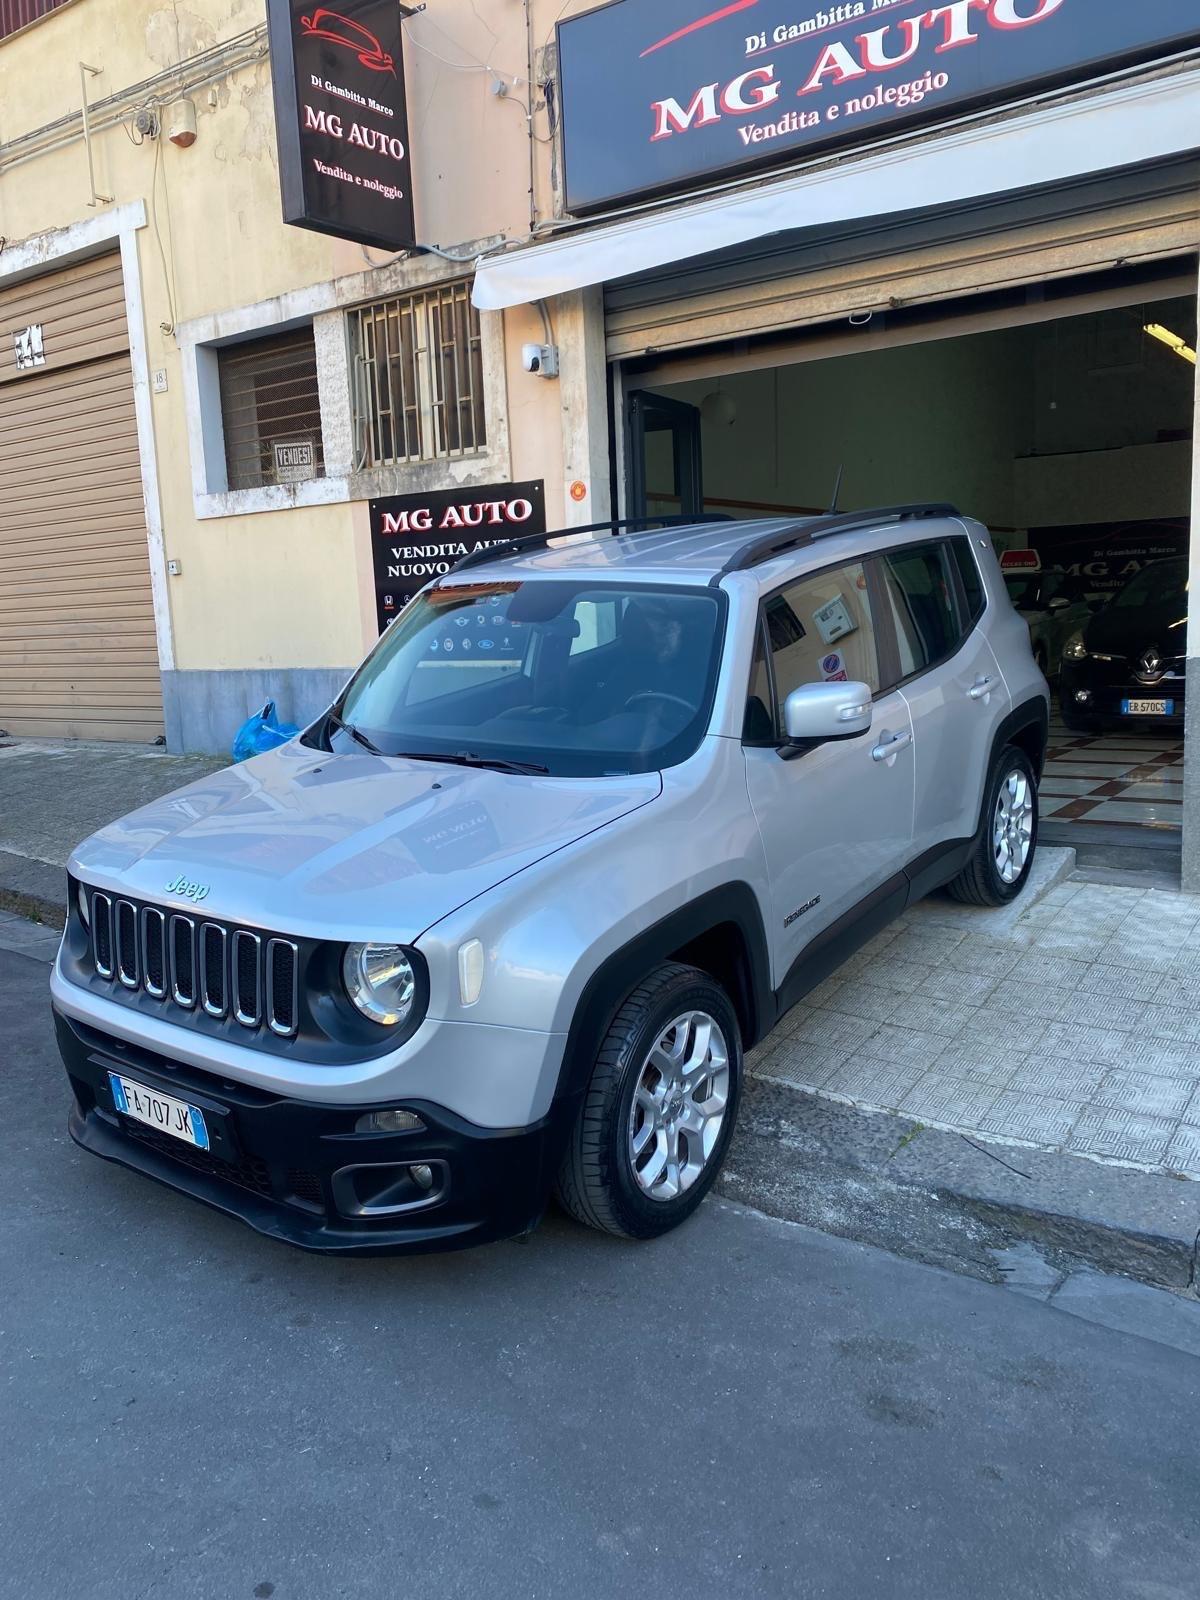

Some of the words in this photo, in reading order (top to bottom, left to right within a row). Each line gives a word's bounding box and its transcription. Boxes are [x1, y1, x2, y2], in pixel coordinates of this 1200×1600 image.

[745, 32, 767, 54] Di
[773, 1, 866, 44] Gambitta
[311, 74, 323, 88] Di
[325, 80, 366, 106] Gambitta
[368, 98, 394, 117] Marco
[650, 64, 781, 142] MG
[738, 111, 821, 146] Vendita
[826, 104, 840, 121] e
[844, 69, 949, 116] noleggio
[304, 104, 343, 138] MG
[348, 123, 405, 160] AUTO
[313, 158, 354, 184] Vendita
[355, 176, 362, 186] e
[363, 179, 403, 200] noleggio
[155, 372, 164, 384] 18
[277, 446, 311, 466] VENDESI
[381, 508, 433, 534] MG
[438, 498, 533, 529] AUTO
[387, 561, 450, 577] NUOVO
[391, 542, 469, 560] VENDITA
[163, 872, 210, 903] Jeep
